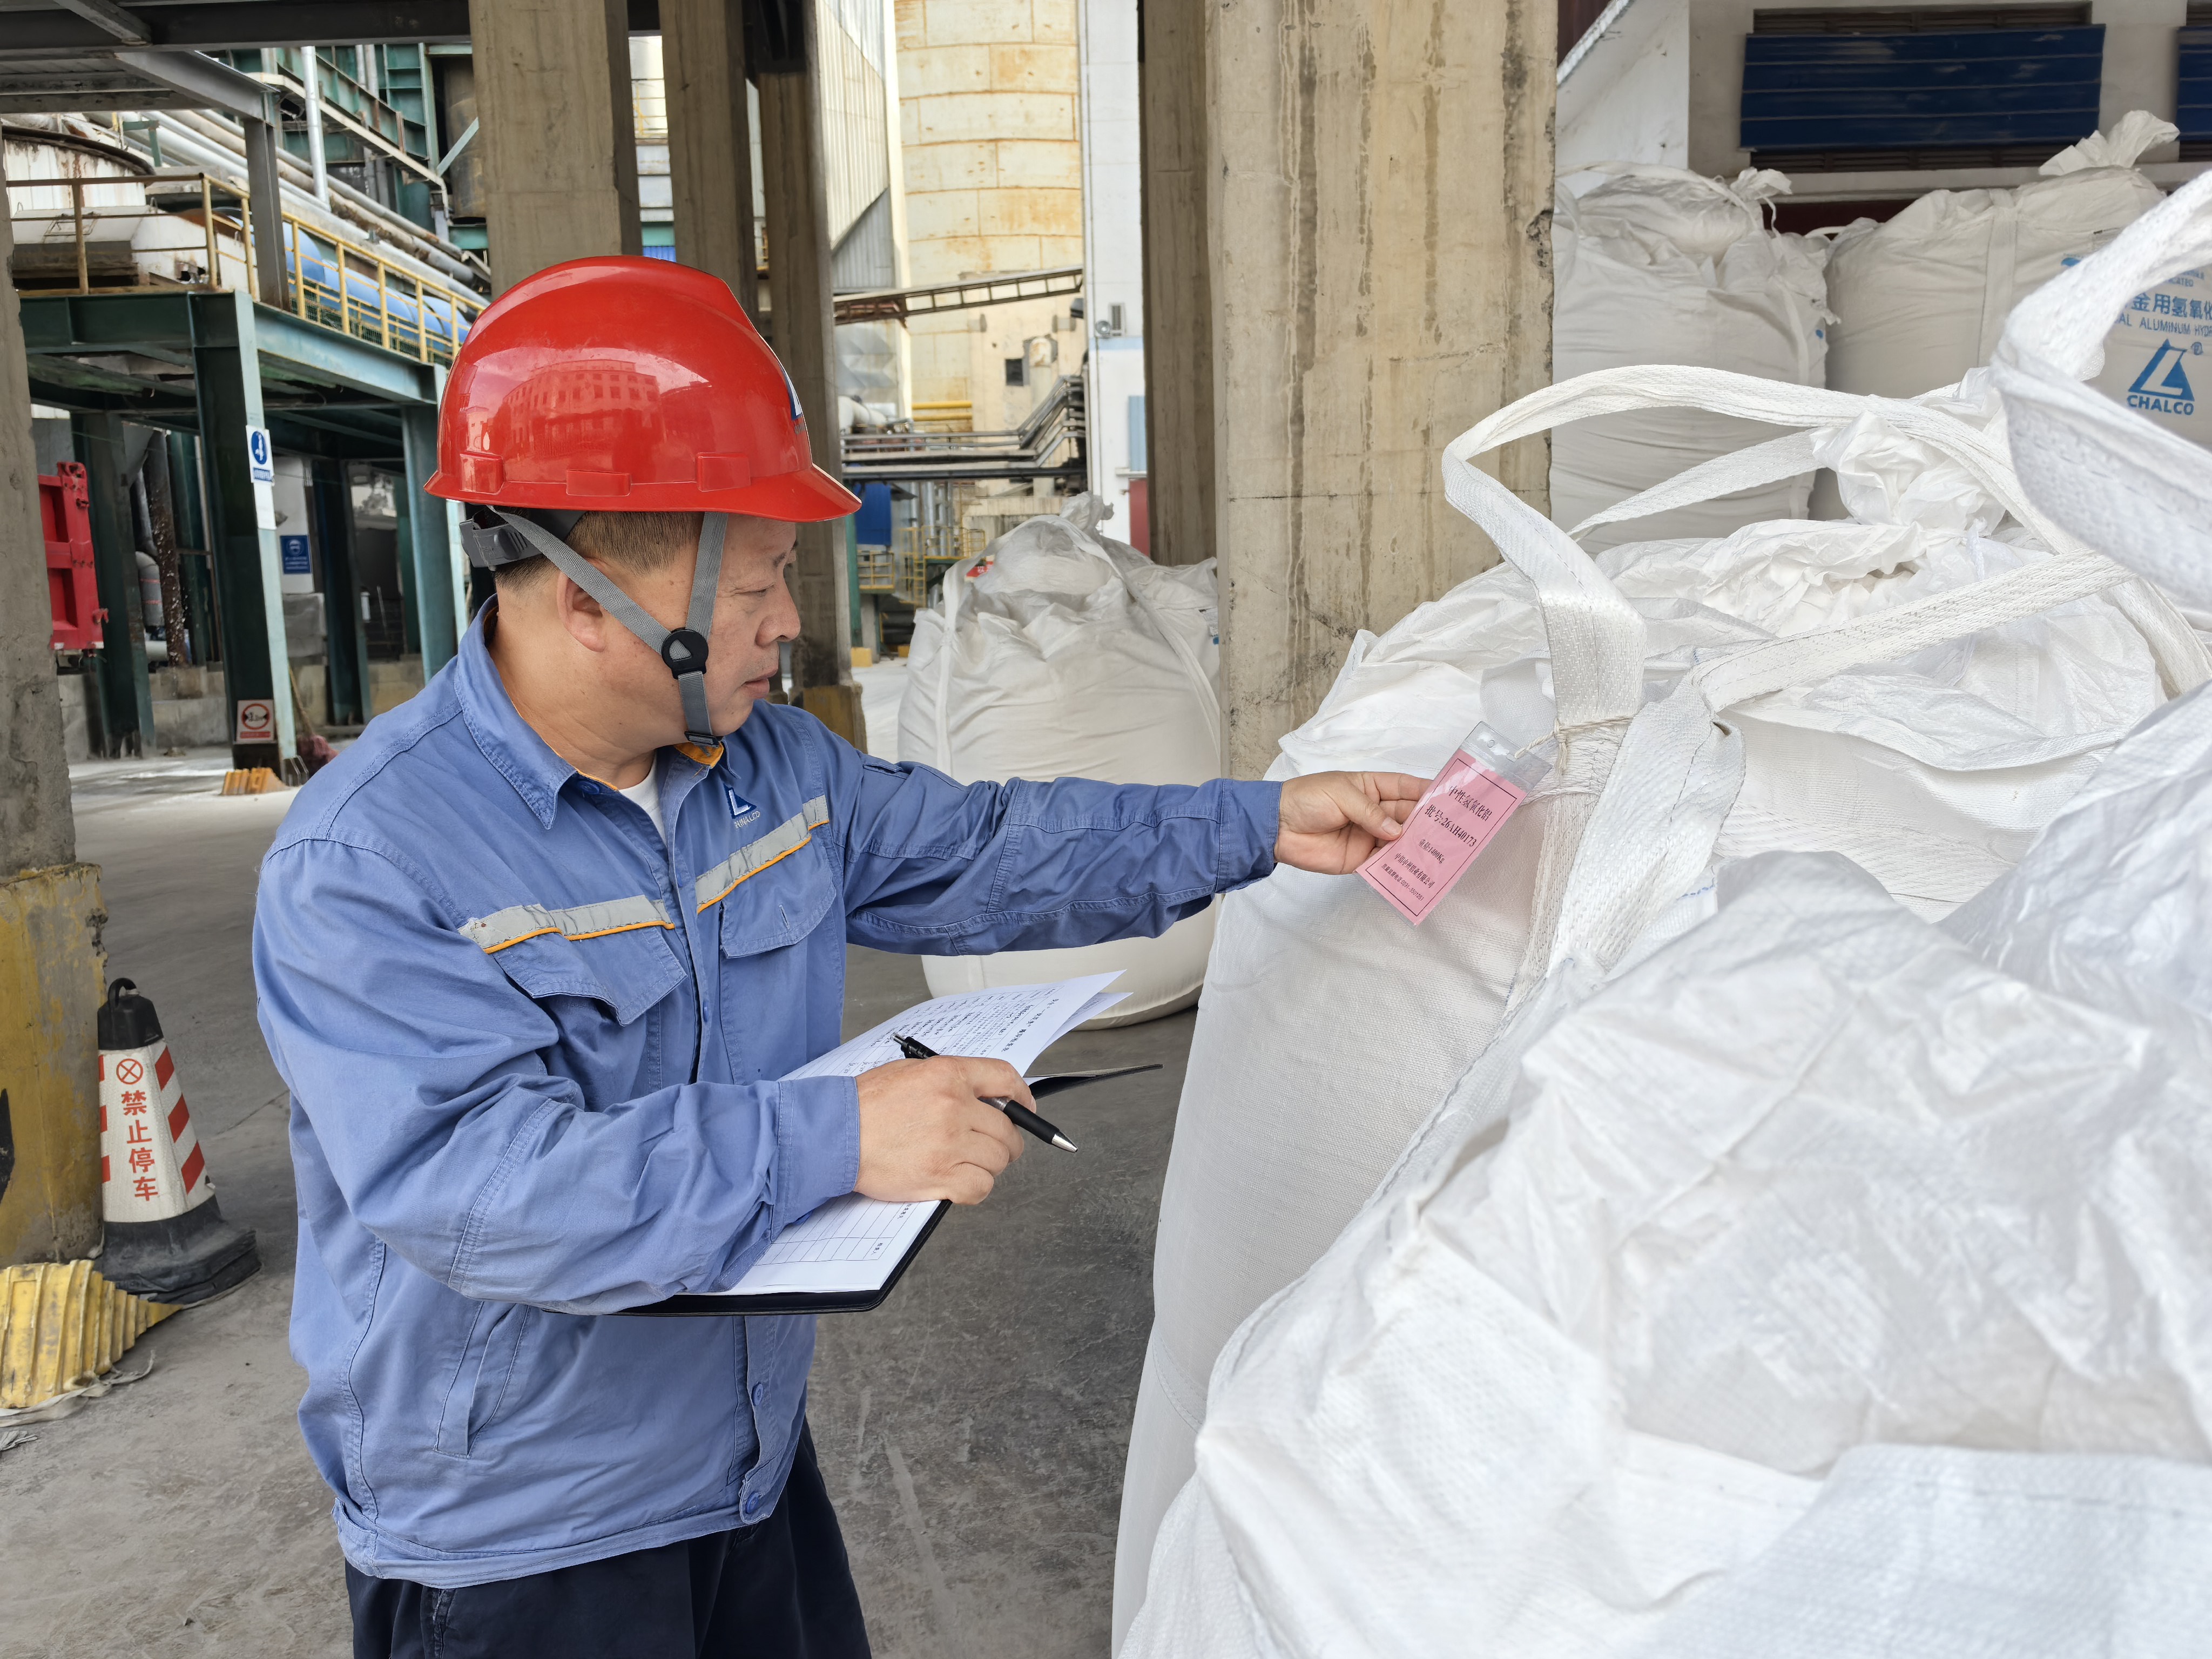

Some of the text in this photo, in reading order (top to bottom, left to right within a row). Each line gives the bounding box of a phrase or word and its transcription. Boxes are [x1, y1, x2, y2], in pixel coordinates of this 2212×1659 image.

[2139, 316, 2191, 334] ALUMINUM
[2126, 395, 2195, 415] CHALCO
[1449, 785, 1493, 821] 中性氢氧化铝
[120, 1090, 158, 1202] 禁止停车
